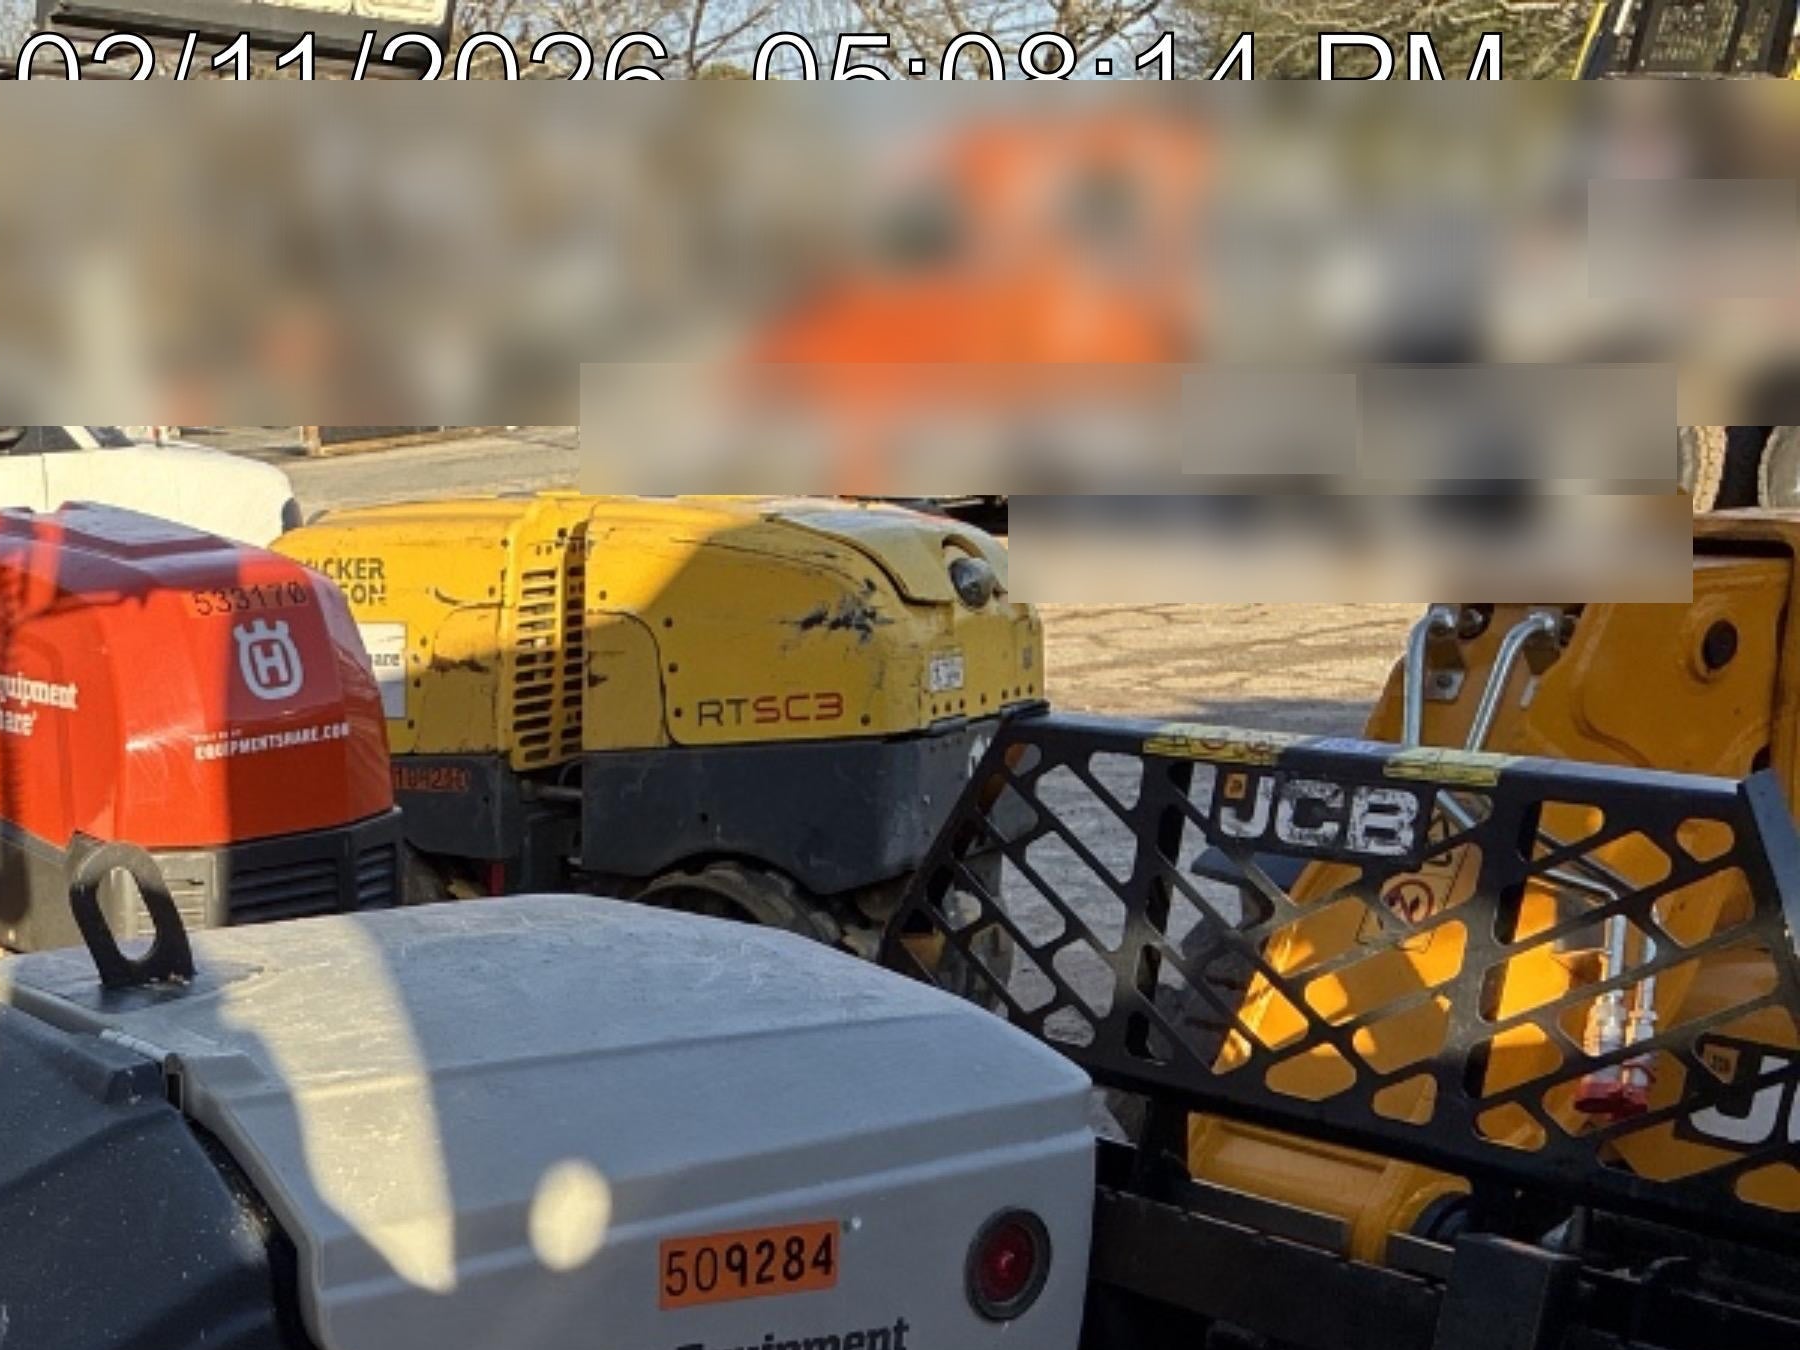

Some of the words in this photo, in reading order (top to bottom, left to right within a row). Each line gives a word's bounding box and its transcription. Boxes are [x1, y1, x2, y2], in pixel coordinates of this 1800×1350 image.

[697, 692, 843, 727] RTSC3
[1220, 776, 1419, 856] JCB
[664, 1232, 835, 1297] 509284
